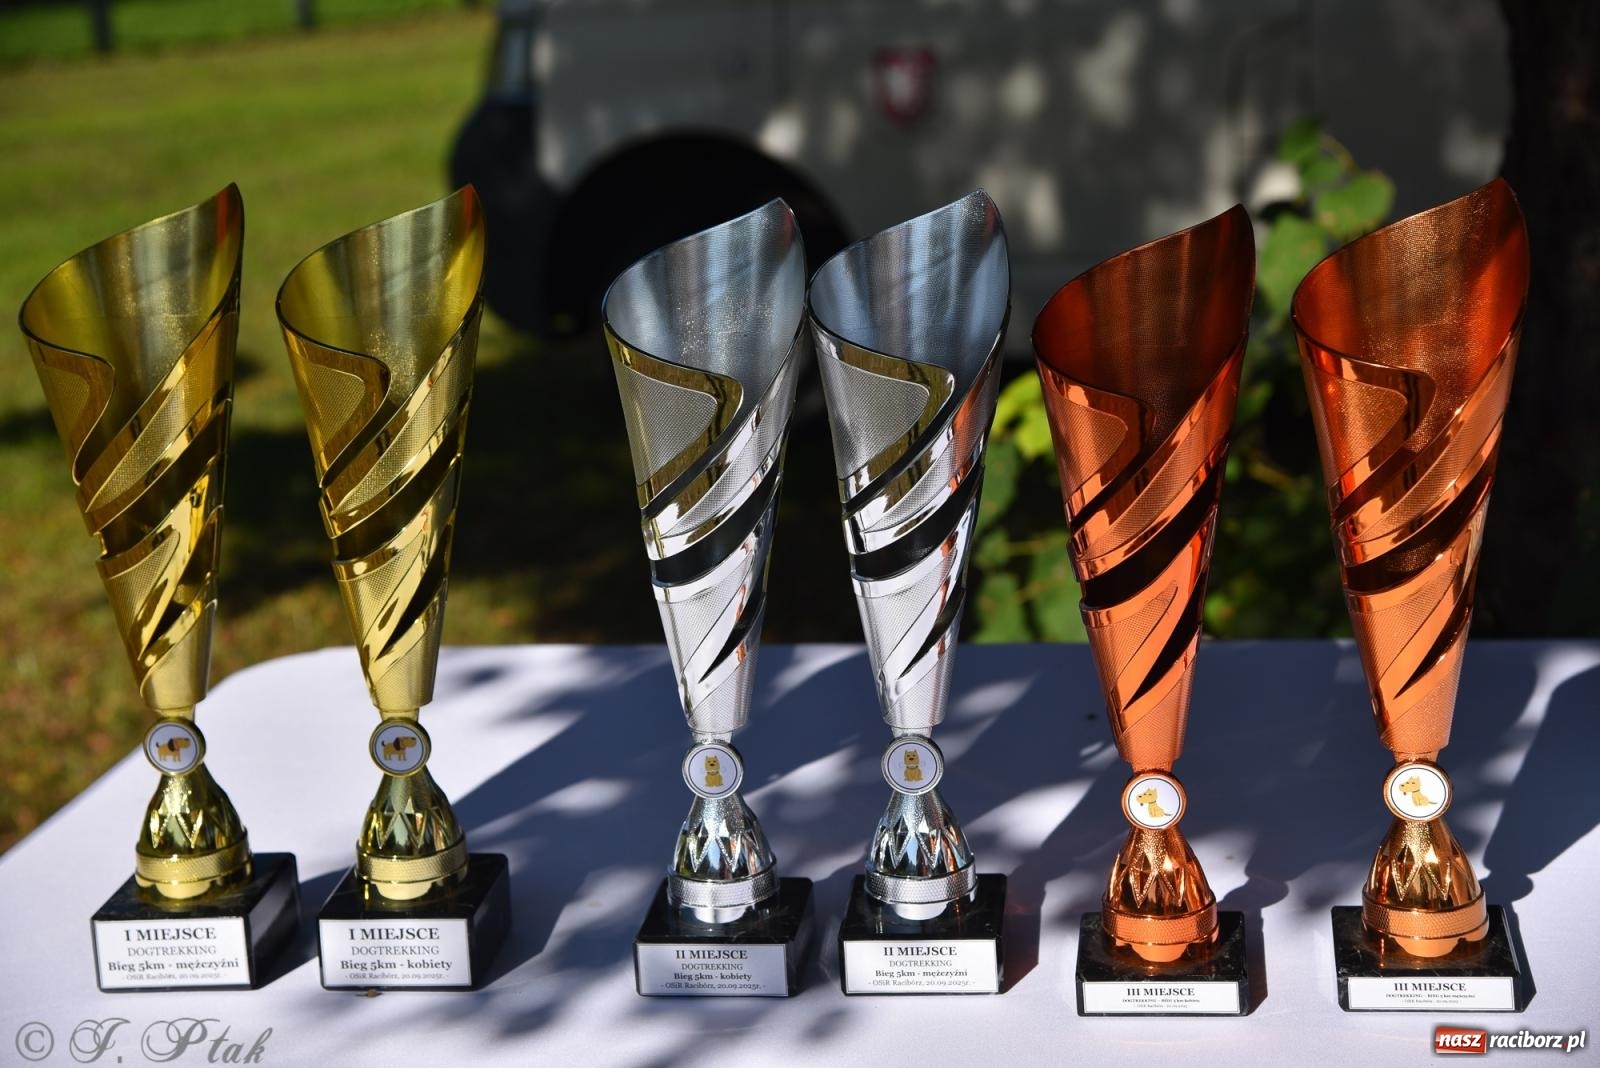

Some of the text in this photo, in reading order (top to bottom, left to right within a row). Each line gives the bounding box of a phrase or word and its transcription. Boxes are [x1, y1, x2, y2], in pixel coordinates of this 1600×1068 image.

[125, 927, 216, 941] I MIEJSCE
[349, 927, 439, 940] I MIEJSCE
[127, 945, 216, 957] DOGTREKKING
[351, 945, 439, 956] DOGTREKKING
[676, 950, 748, 959] II MIEJSCE
[884, 946, 957, 956] II MIEJSCE
[108, 961, 135, 972] Bieg
[138, 960, 165, 972] 5km
[176, 958, 239, 971] mężczyźni
[340, 960, 367, 971] Bieg
[370, 959, 396, 971] 5km
[407, 959, 452, 971] kobiety
[681, 963, 743, 971] DOGTREKKING
[674, 973, 693, 981] Bieg
[694, 973, 713, 981] 5km
[720, 973, 752, 981] kobiety
[875, 970, 895, 978] Bieg
[896, 970, 915, 978] 5km
[922, 969, 968, 978] mężczyźni
[1127, 988, 1195, 996] III MIEJSCE
[1394, 983, 1467, 991] III MIEJSCE
